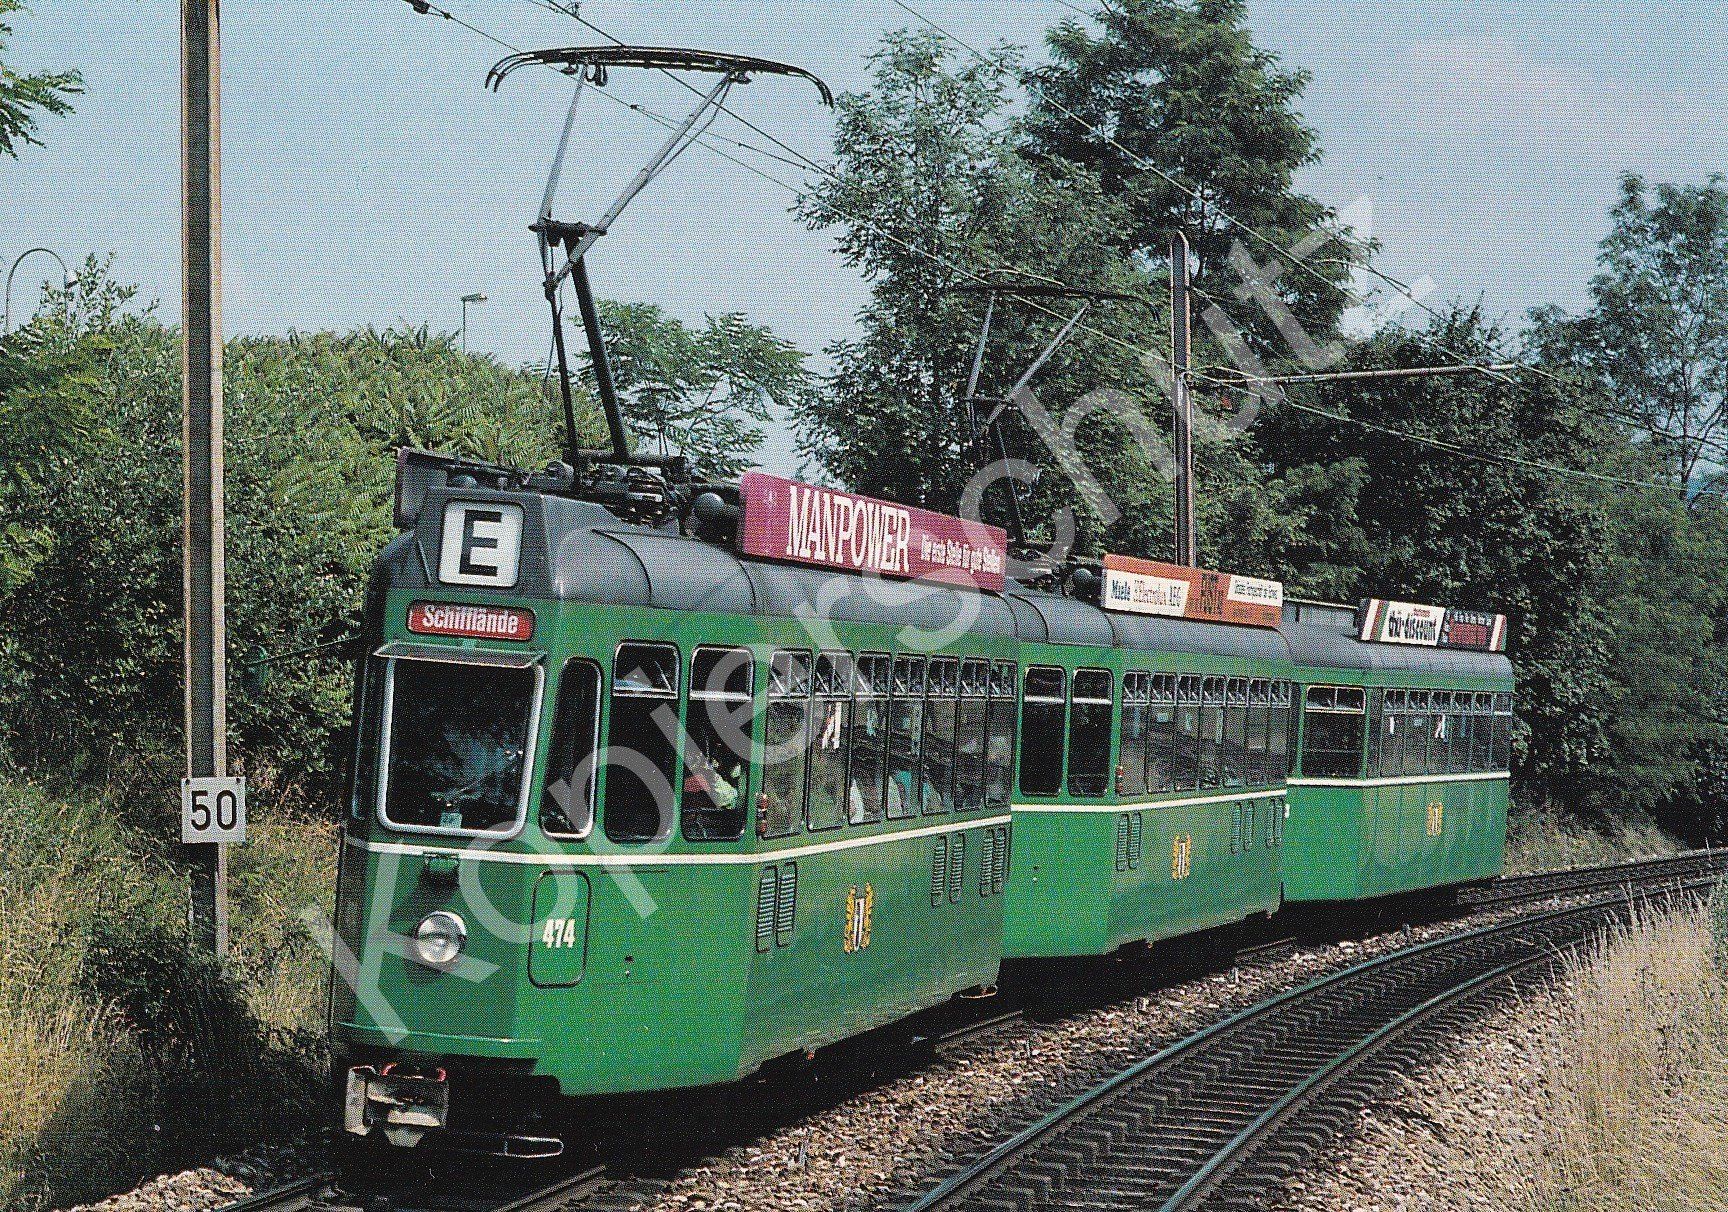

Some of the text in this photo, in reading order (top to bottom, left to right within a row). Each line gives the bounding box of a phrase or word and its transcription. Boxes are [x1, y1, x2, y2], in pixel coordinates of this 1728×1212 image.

[459, 508, 503, 577] E
[786, 485, 912, 573] MANPOWER
[1111, 579, 1131, 602] Miele
[422, 604, 519, 634] Schifflände
[191, 790, 238, 832] 50
[542, 918, 576, 949] 474
